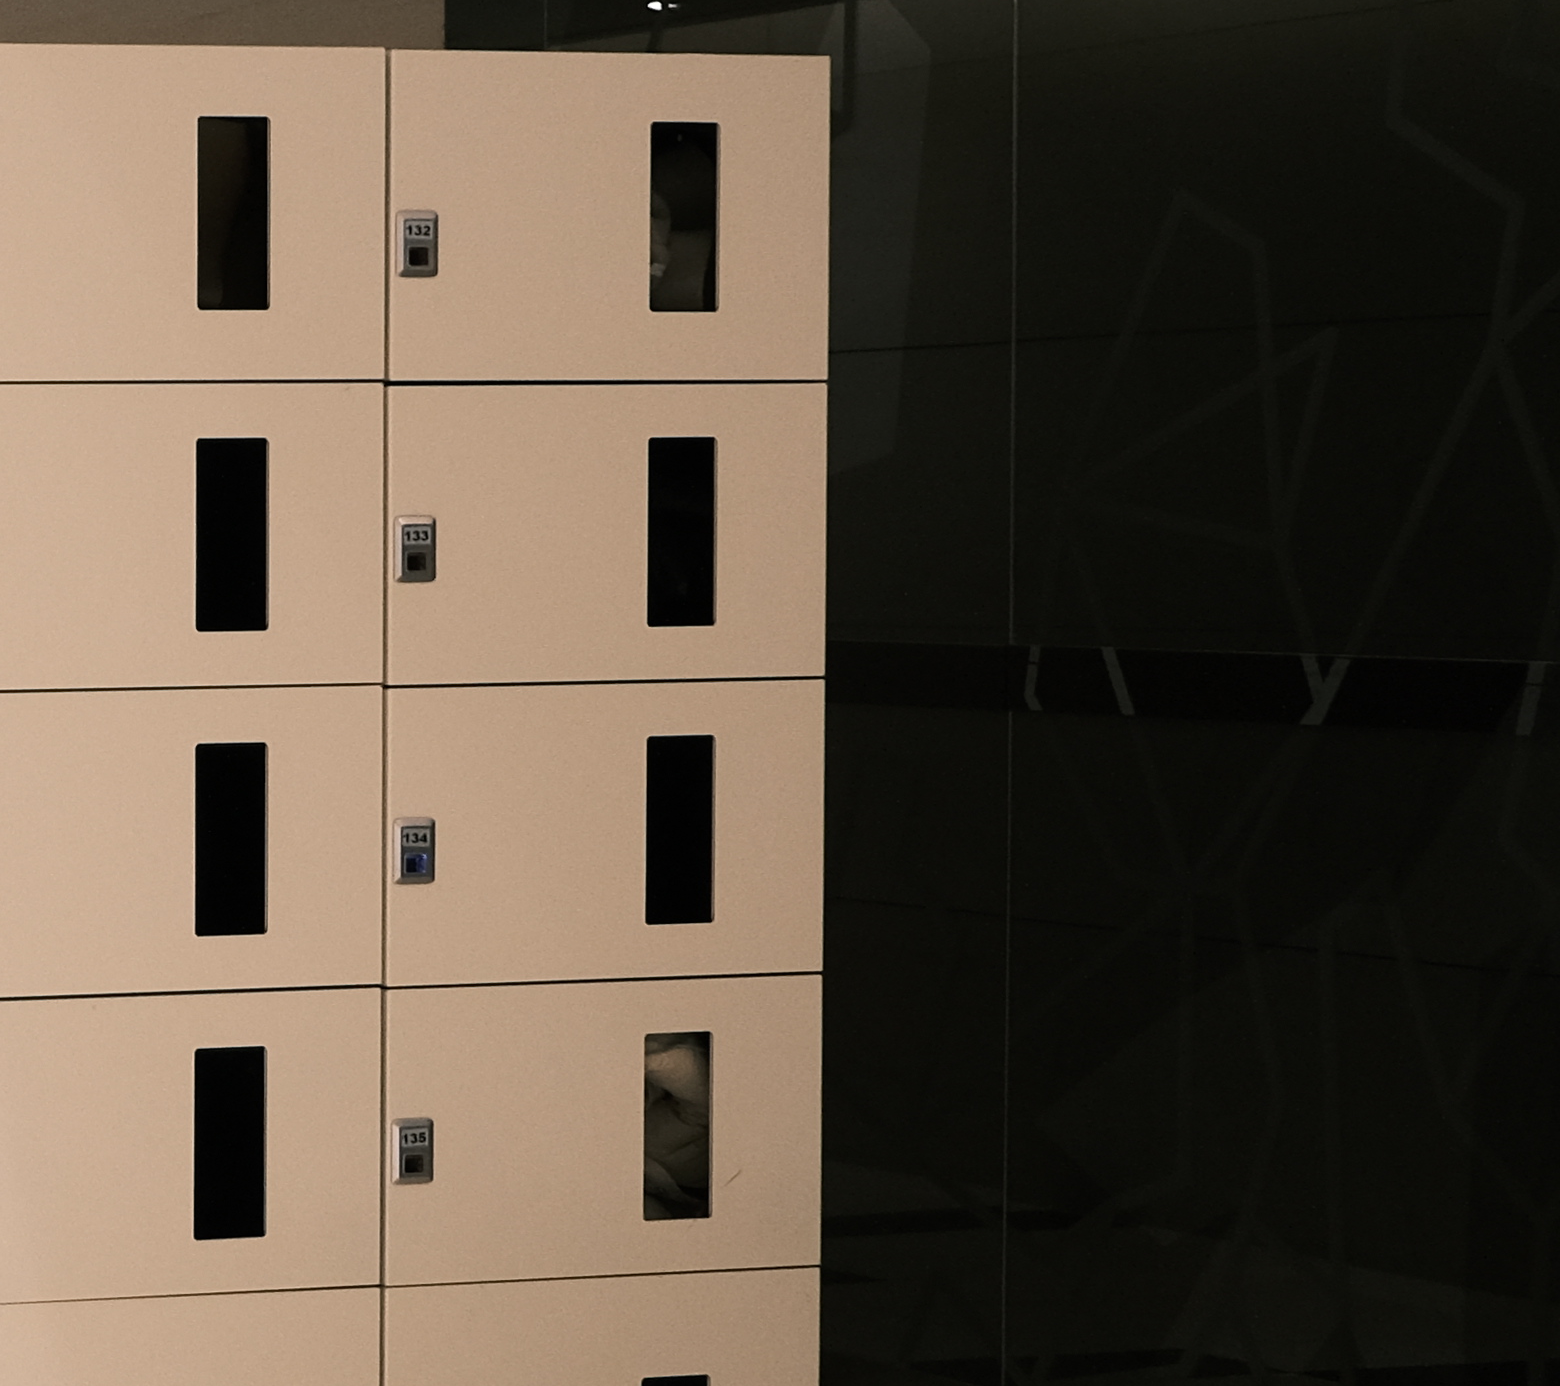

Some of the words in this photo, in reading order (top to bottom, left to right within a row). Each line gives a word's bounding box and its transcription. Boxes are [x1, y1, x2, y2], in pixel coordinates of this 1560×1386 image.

[406, 225, 430, 236] 132
[404, 531, 428, 541] 133
[402, 833, 428, 843] 134
[403, 1134, 426, 1143] 135
